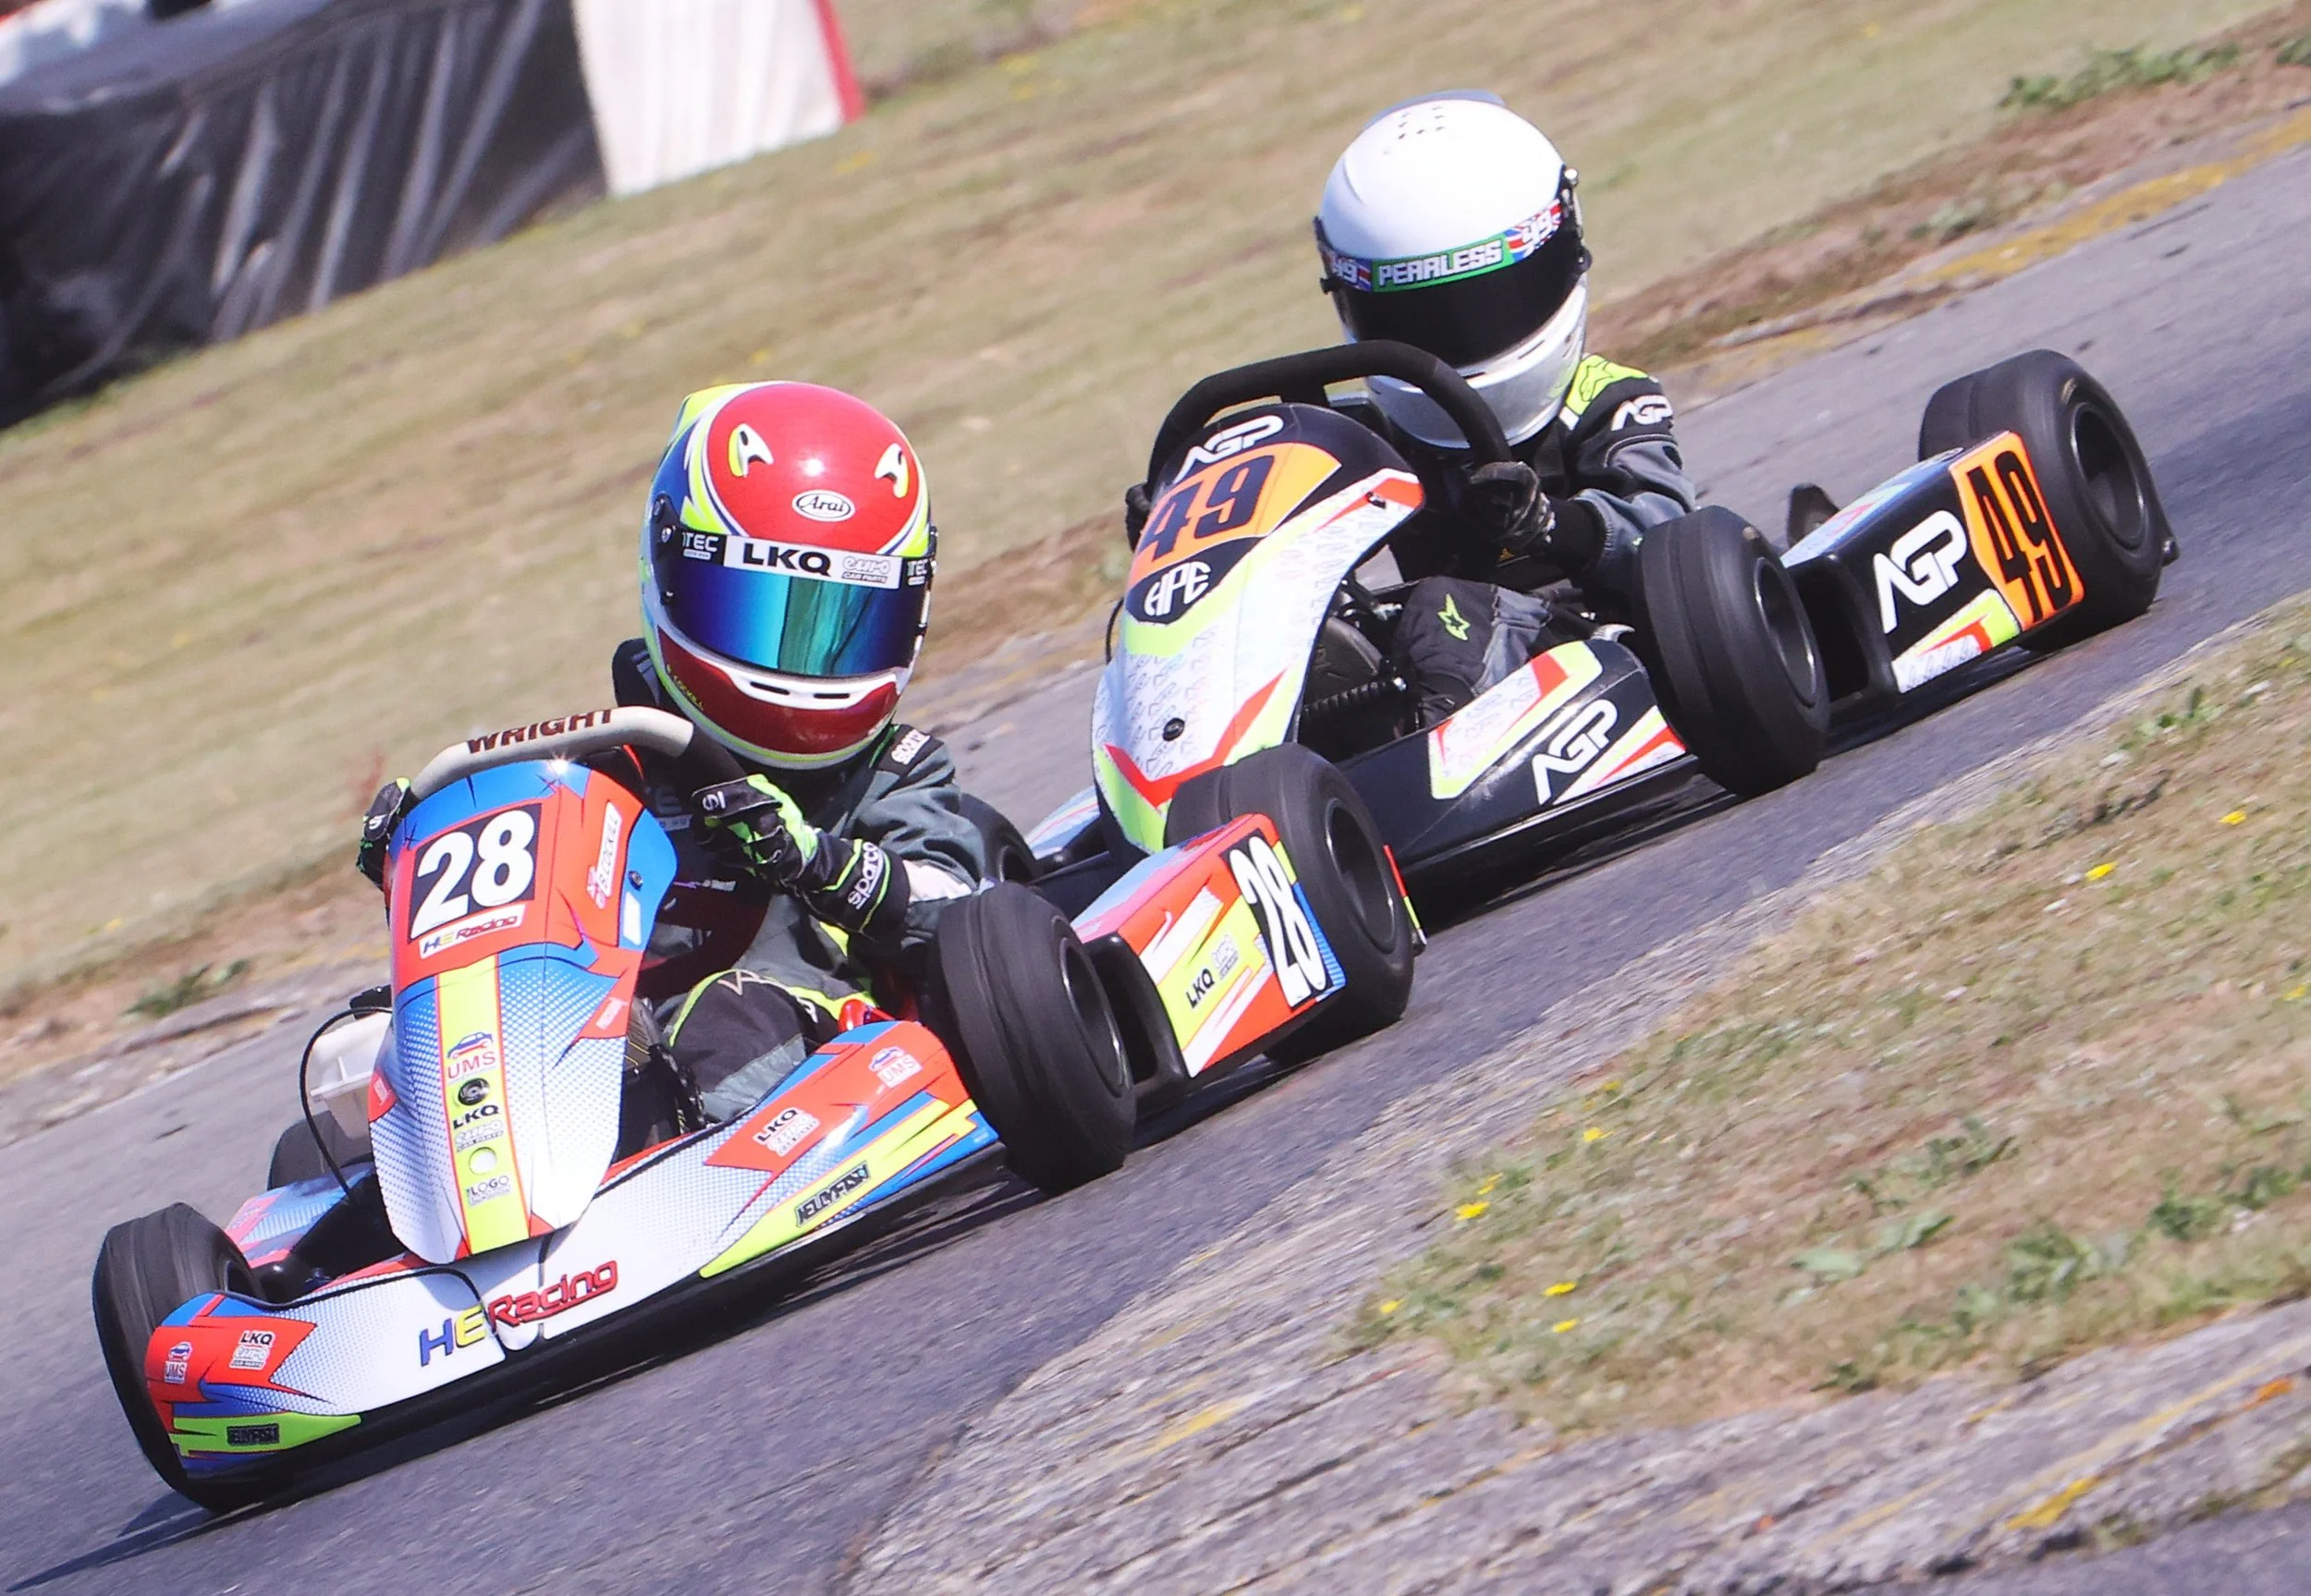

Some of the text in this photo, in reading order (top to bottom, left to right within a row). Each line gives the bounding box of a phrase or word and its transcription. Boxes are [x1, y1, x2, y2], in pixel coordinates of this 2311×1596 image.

[1379, 240, 1503, 286] PEARLESS
[1611, 395, 1673, 431] AGP
[1172, 414, 1284, 485] AGP
[807, 493, 847, 514] Arai
[1142, 455, 1276, 562] 49
[742, 542, 831, 578] LKQ
[1966, 450, 2073, 624] 49
[1874, 510, 1967, 635] AGP
[466, 709, 612, 755] WRIGHT
[1532, 699, 1618, 806] AGP
[410, 810, 534, 940] 28
[848, 842, 883, 909] sparco
[1229, 835, 1327, 1008] 28
[1185, 968, 1216, 1009] LKQ
[447, 1052, 495, 1078] UMS
[881, 1057, 916, 1082] UMS
[452, 1104, 499, 1129] LKQ
[757, 1110, 798, 1141] LKQ
[419, 1261, 619, 1368] HE Racing
[240, 1333, 274, 1346] LKQ
